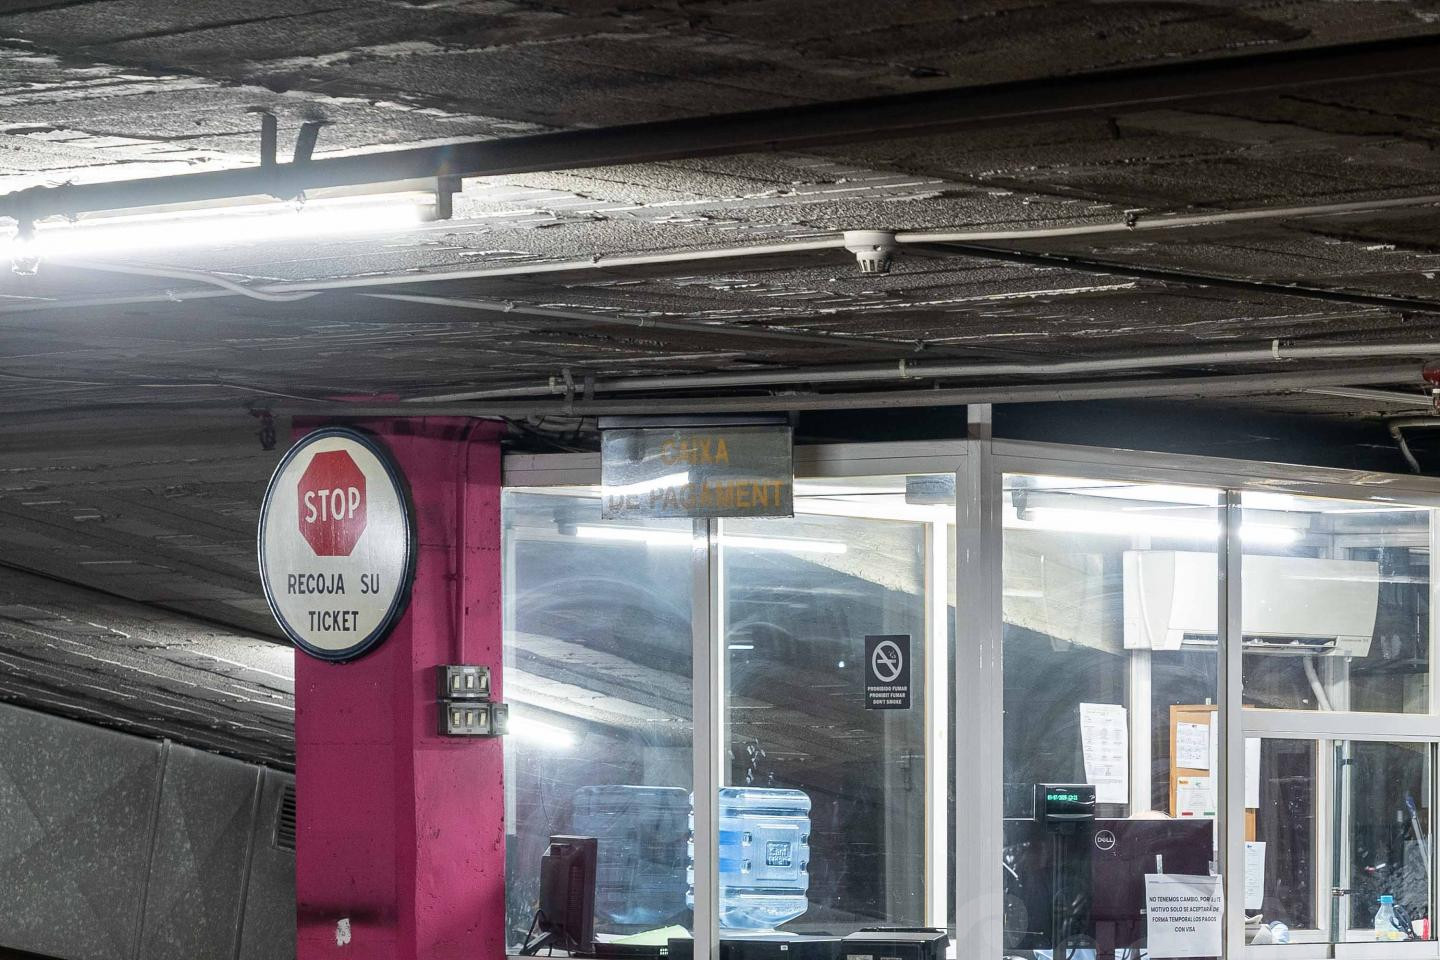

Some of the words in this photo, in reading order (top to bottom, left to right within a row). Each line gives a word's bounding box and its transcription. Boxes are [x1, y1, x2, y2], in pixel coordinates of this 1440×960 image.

[661, 435, 729, 466] CAIXA
[304, 487, 361, 523] STOP
[287, 573, 345, 595] RECOJA
[360, 573, 380, 595] SU
[308, 610, 359, 632] TICKET
